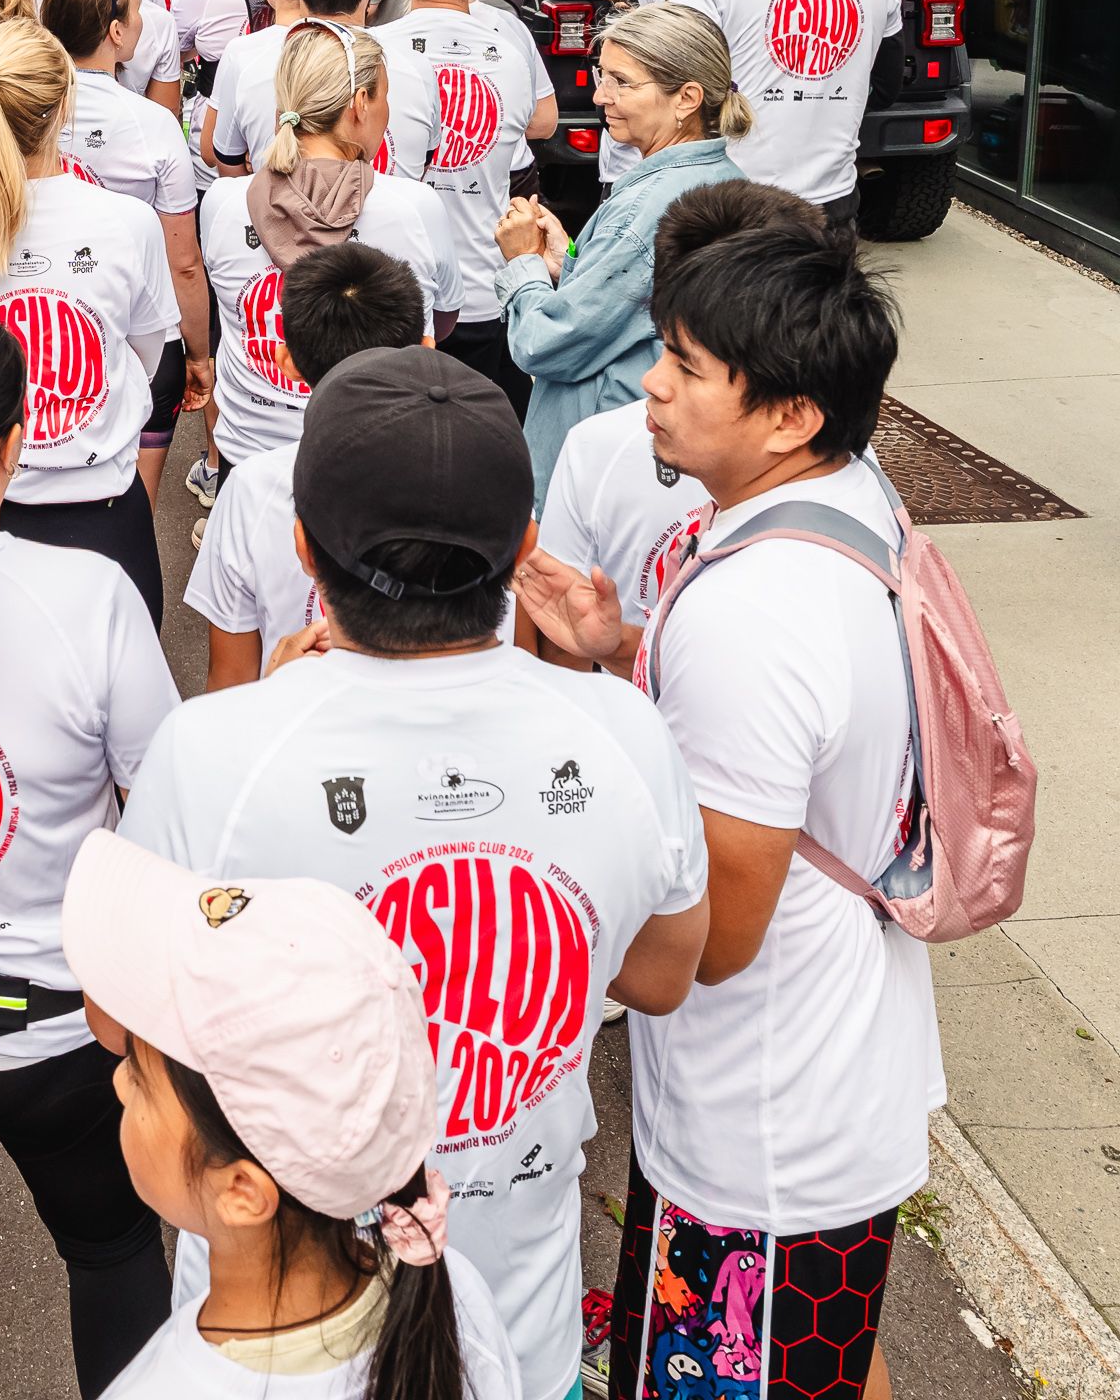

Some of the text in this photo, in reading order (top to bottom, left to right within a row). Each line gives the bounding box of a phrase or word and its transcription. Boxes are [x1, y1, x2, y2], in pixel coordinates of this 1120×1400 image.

[772, 34, 810, 75] RUN
[808, 38, 850, 76] 2026
[435, 68, 498, 146] SILON
[440, 130, 487, 168] 2026
[68, 260, 99, 268] TORSHOV
[72, 266, 94, 274] SPORT
[14, 287, 40, 296] RUNNING
[40, 287, 55, 295] CLUB
[55, 289, 69, 299] 2026
[75, 297, 94, 315] YPSILON
[251, 396, 276, 408] Red Bull
[33, 387, 96, 441] 2026
[28, 434, 75, 450] YPSILON RUNNING
[640, 520, 682, 600] YPSILON RUNNING CLUB 2026
[2, 761, 16, 781] CLUB
[8, 778, 18, 797] 2026
[418, 790, 490, 802] Kvinnehelsehus
[538, 786, 596, 804] TORSHOV
[338, 801, 358, 811] UTEN
[434, 800, 474, 808] Drammen
[548, 800, 588, 816] SPORT
[6, 806, 20, 834] YPSILON
[382, 840, 536, 878] YPSILON RUNNING CLUB 2026
[354, 882, 374, 902] 026
[548, 862, 600, 932] YPSILON RUNNING
[366, 858, 590, 1050] PSILON
[446, 1030, 563, 1138] 2026
[524, 1048, 584, 1111] NING CLUB 2026
[436, 1121, 518, 1154] YPSILON RUNNING
[462, 1190, 494, 1199] STATION
